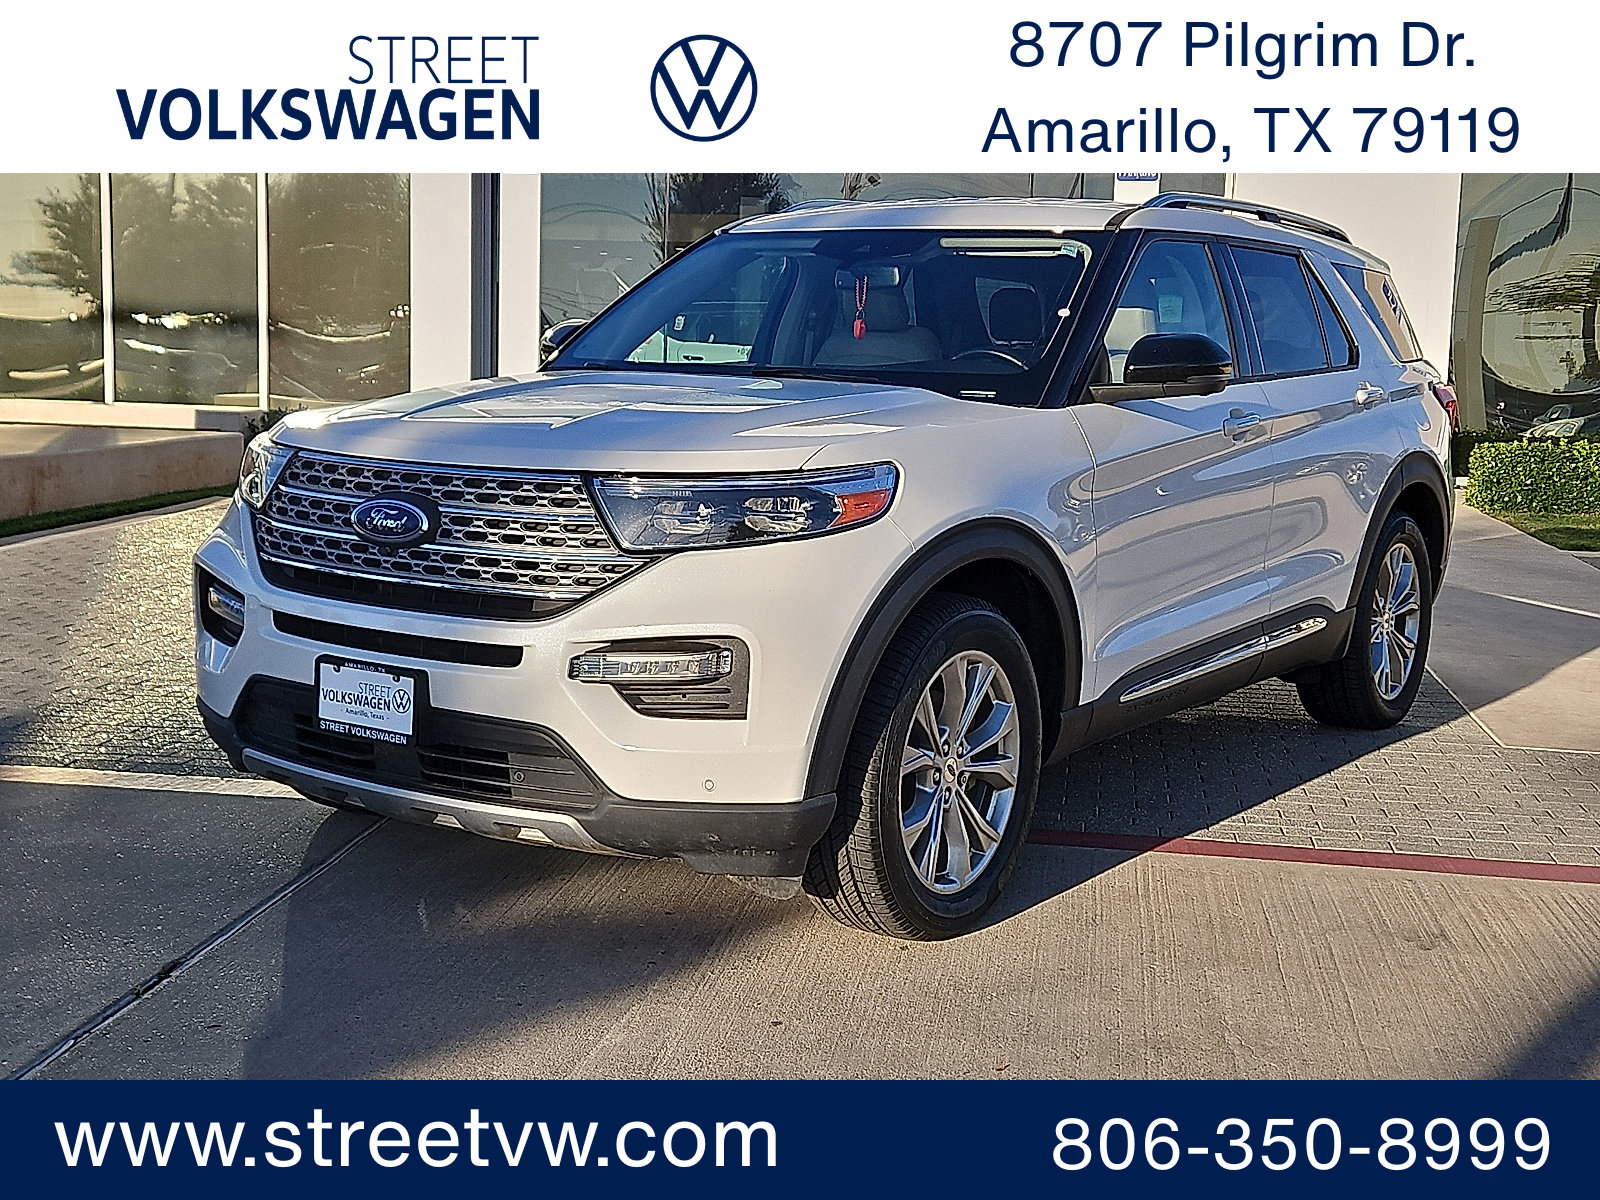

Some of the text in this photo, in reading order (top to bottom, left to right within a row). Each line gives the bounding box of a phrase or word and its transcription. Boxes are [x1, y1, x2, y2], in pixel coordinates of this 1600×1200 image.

[366, 507, 408, 532] Ford
[321, 687, 391, 711] VOLKSWAGEN
[358, 682, 392, 698] STREET
[320, 720, 407, 745] STREET VOLKSWAGEN
